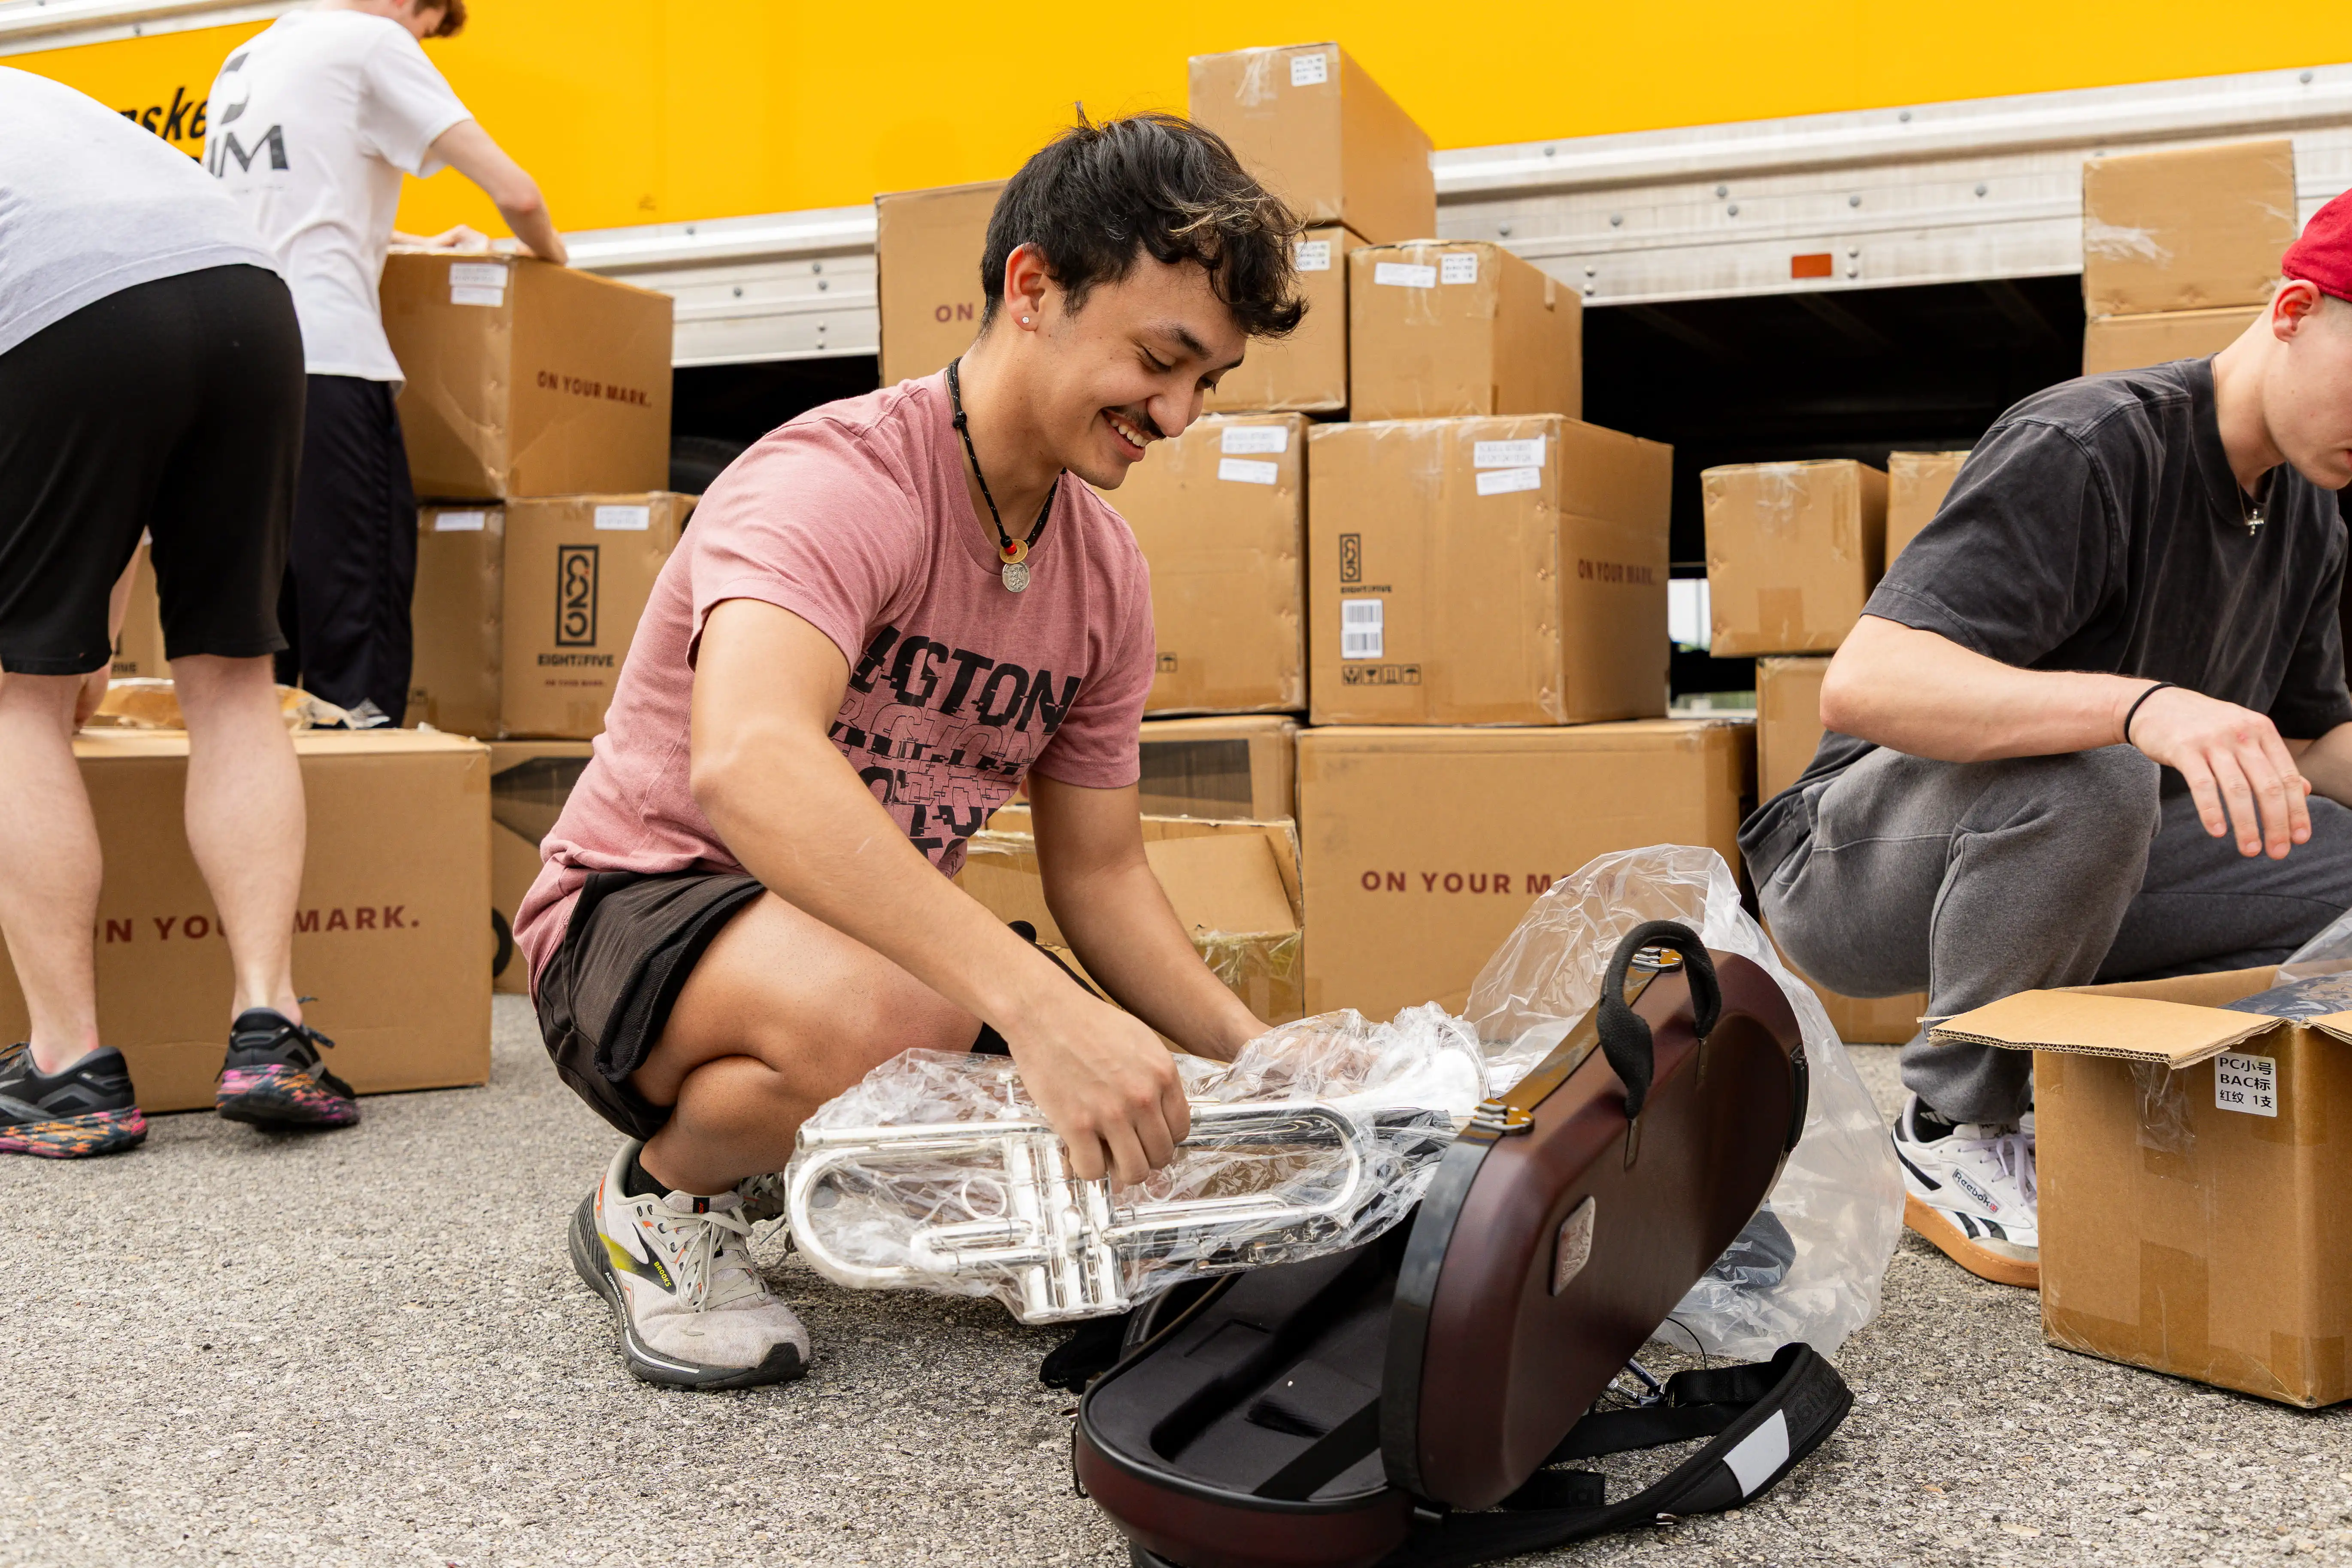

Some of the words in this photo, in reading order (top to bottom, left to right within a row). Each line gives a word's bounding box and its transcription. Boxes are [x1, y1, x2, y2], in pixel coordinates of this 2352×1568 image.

[935, 303, 974, 323] ON
[537, 370, 558, 390] ON
[563, 376, 601, 398] YOUR
[1361, 870, 1406, 892] ON
[1422, 873, 1511, 893] YOUR
[94, 919, 132, 943] N
[294, 905, 420, 934] MARK.
[2219, 1057, 2273, 1075] PC小号
[2220, 1074, 2271, 1091] BAC标
[2219, 1089, 2244, 1104] 红纹
[2253, 1095, 2272, 1109] 1支
[1954, 1171, 1990, 1207] Reebok
[654, 1261, 672, 1287] BROOKS
